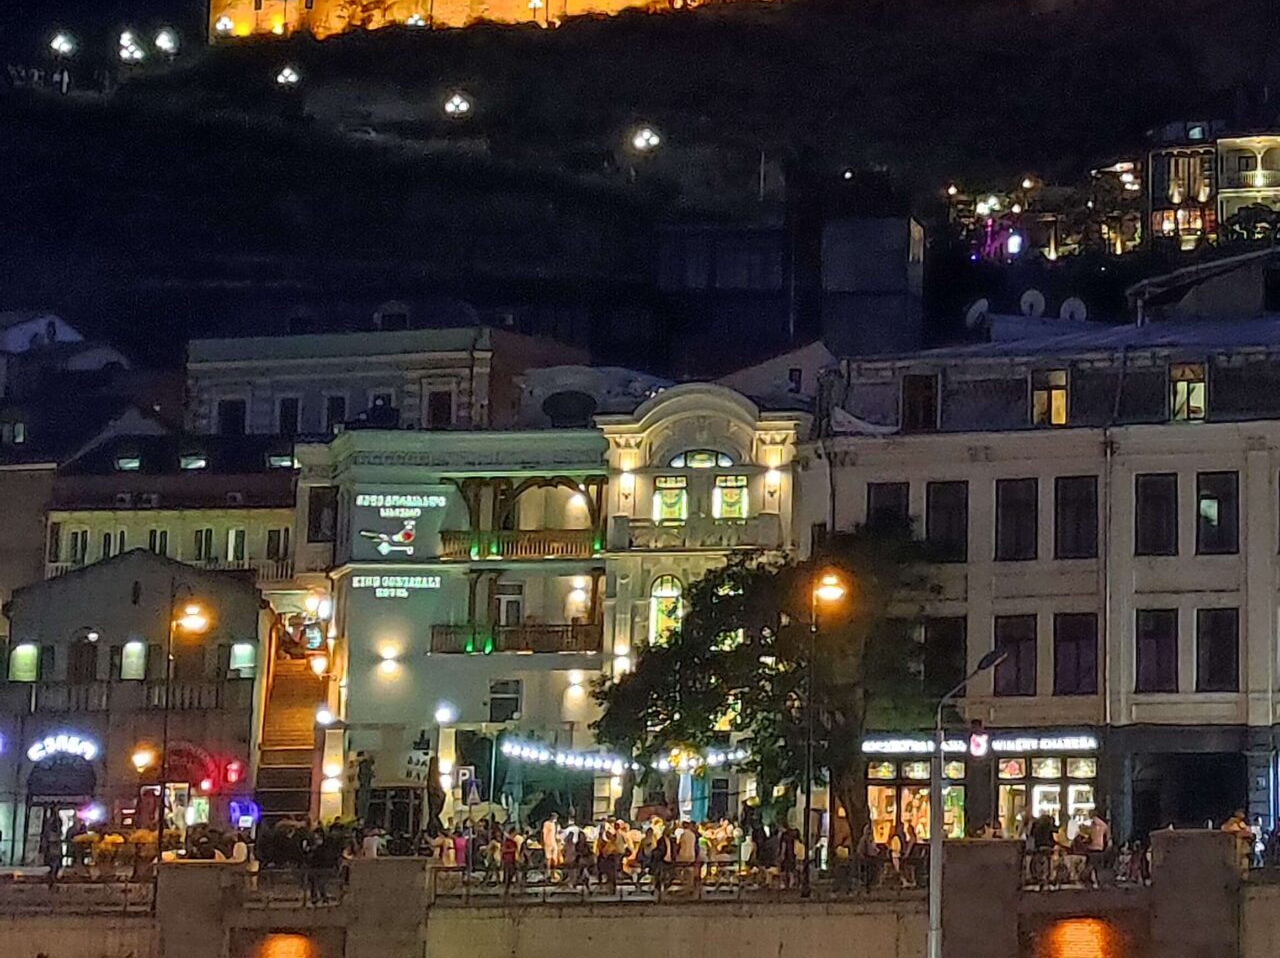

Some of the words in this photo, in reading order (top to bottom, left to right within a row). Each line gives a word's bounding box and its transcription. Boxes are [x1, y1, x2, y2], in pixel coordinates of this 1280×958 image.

[352, 576, 380, 588] KING
[991, 739, 1038, 753] WINERY
[459, 769, 471, 784] P
